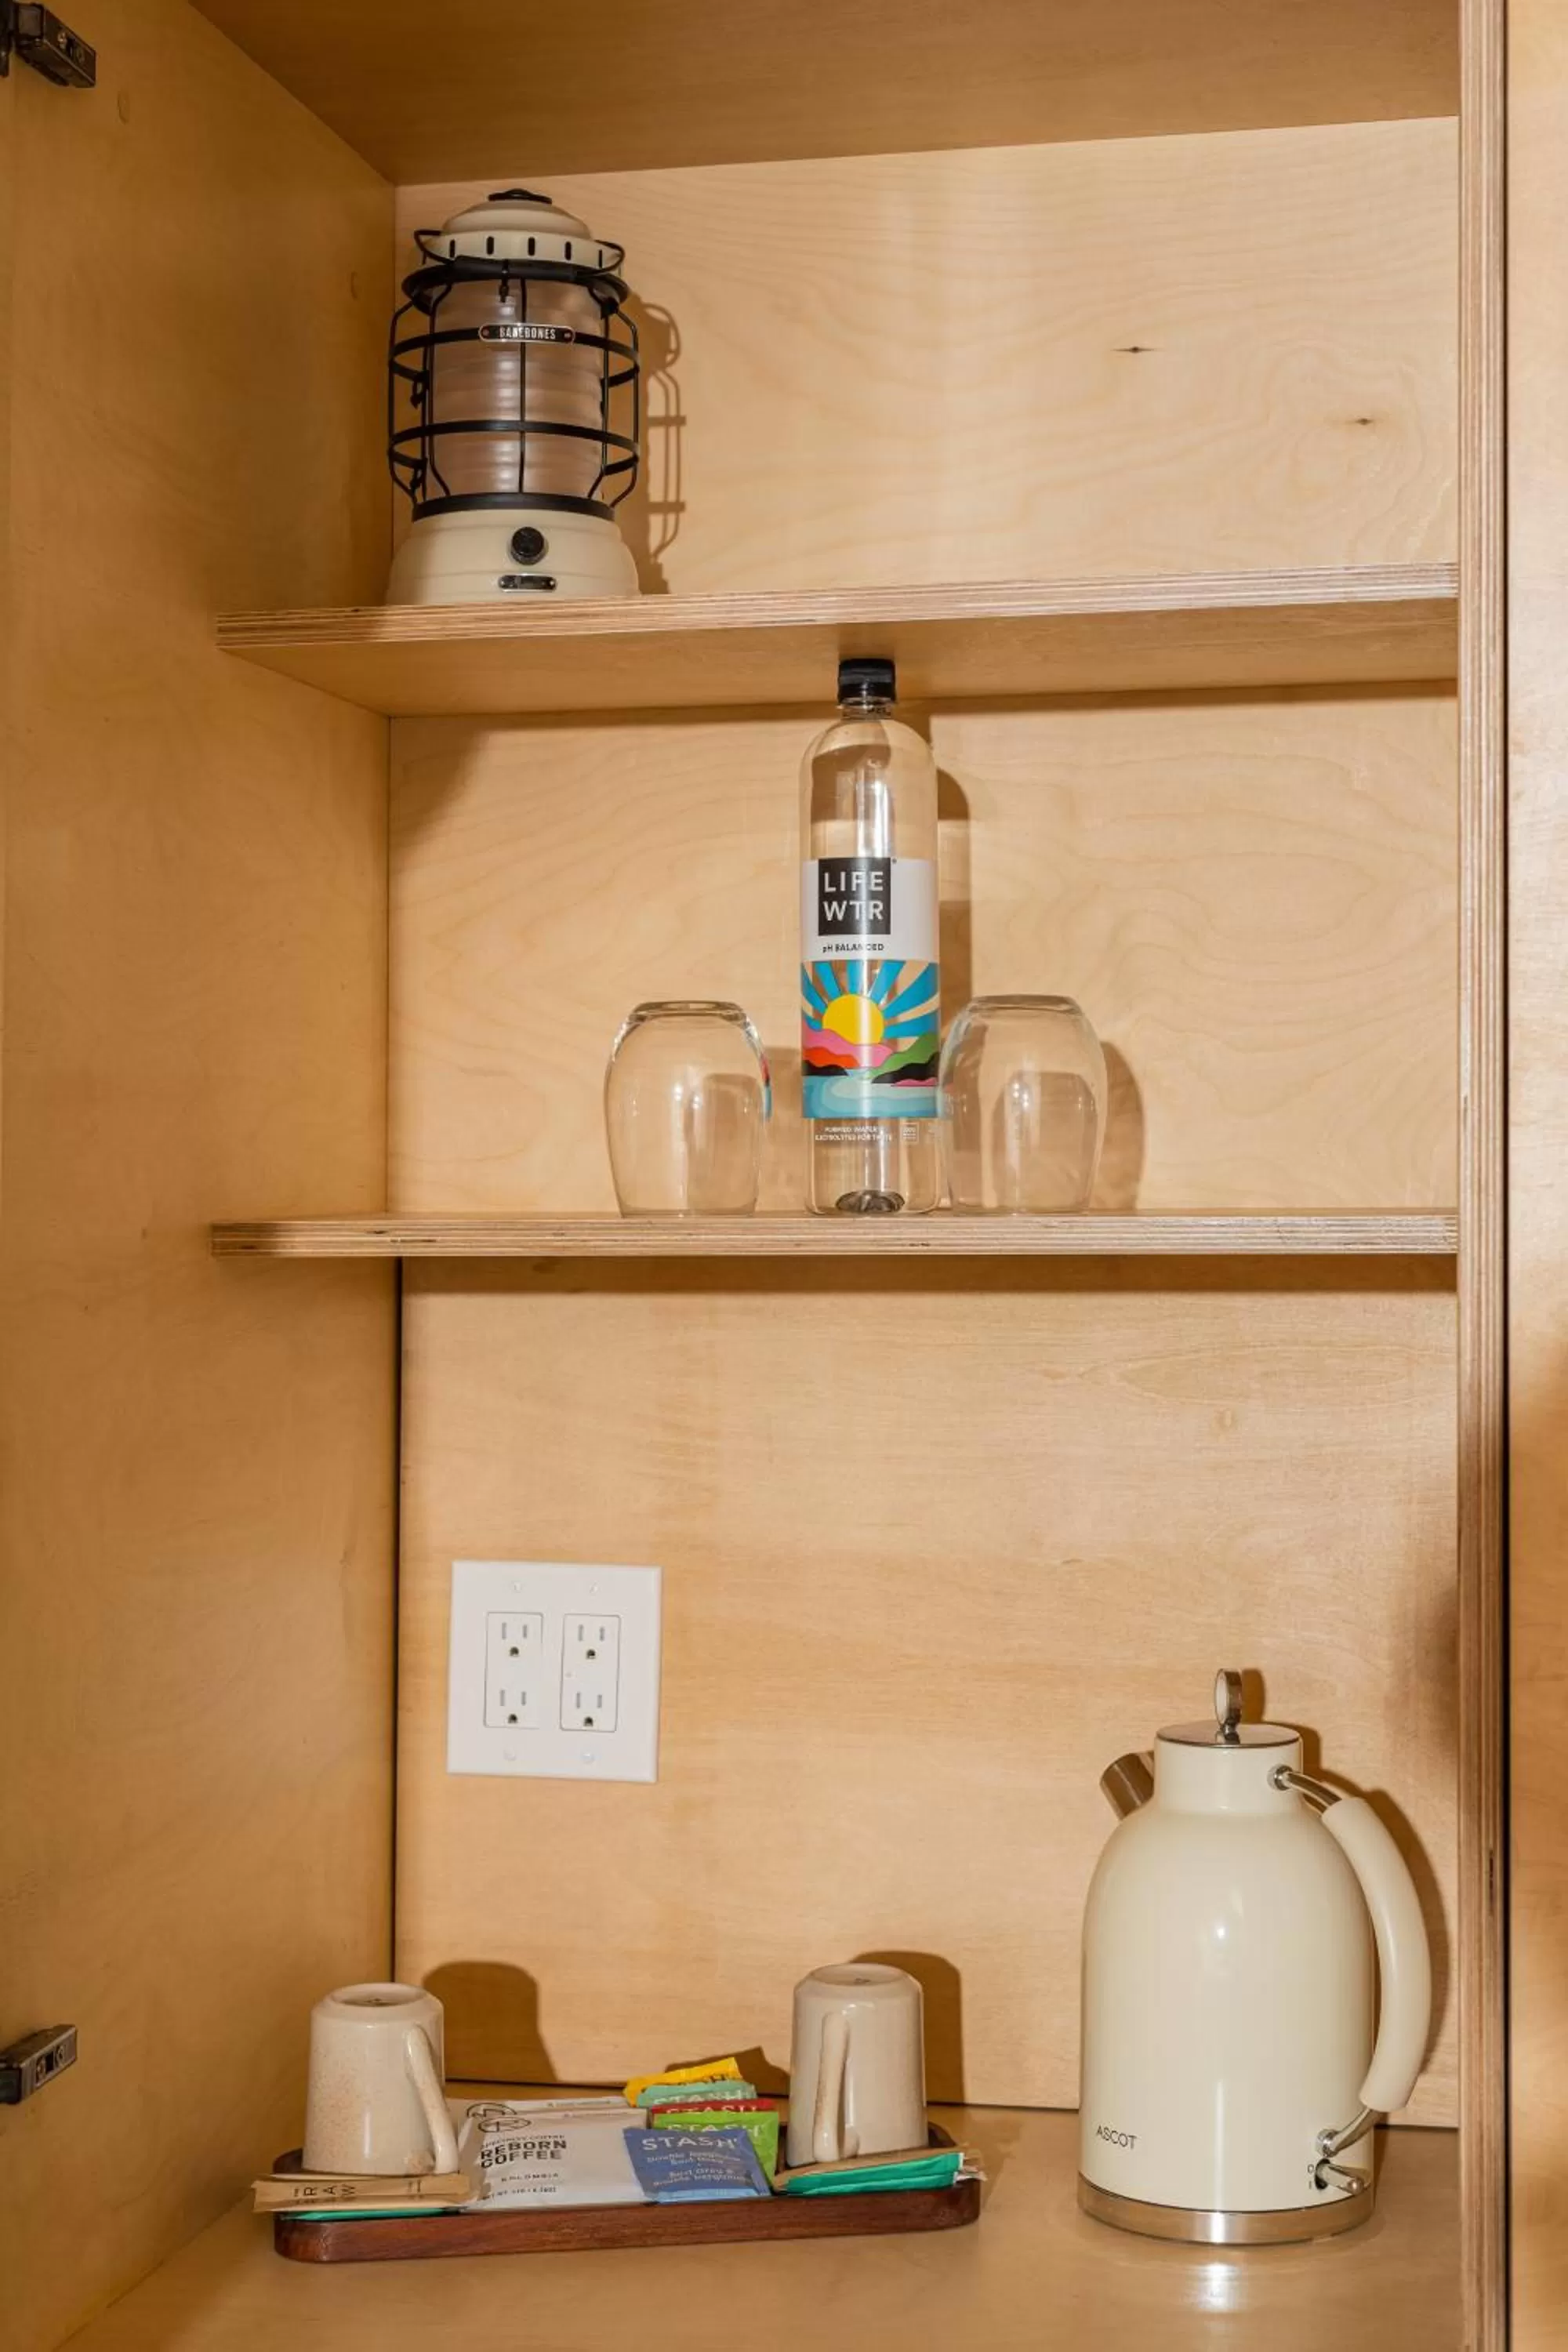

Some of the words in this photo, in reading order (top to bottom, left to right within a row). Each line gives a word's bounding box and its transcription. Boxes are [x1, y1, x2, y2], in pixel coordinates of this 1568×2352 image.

[824, 871, 884, 892] LIFE
[822, 900, 884, 921] WTR
[643, 2136, 737, 2151] STASH
[1096, 2125, 1138, 2150] ASCOT
[481, 2140, 567, 2159] REBORN
[481, 2150, 562, 2169] COFFEE
